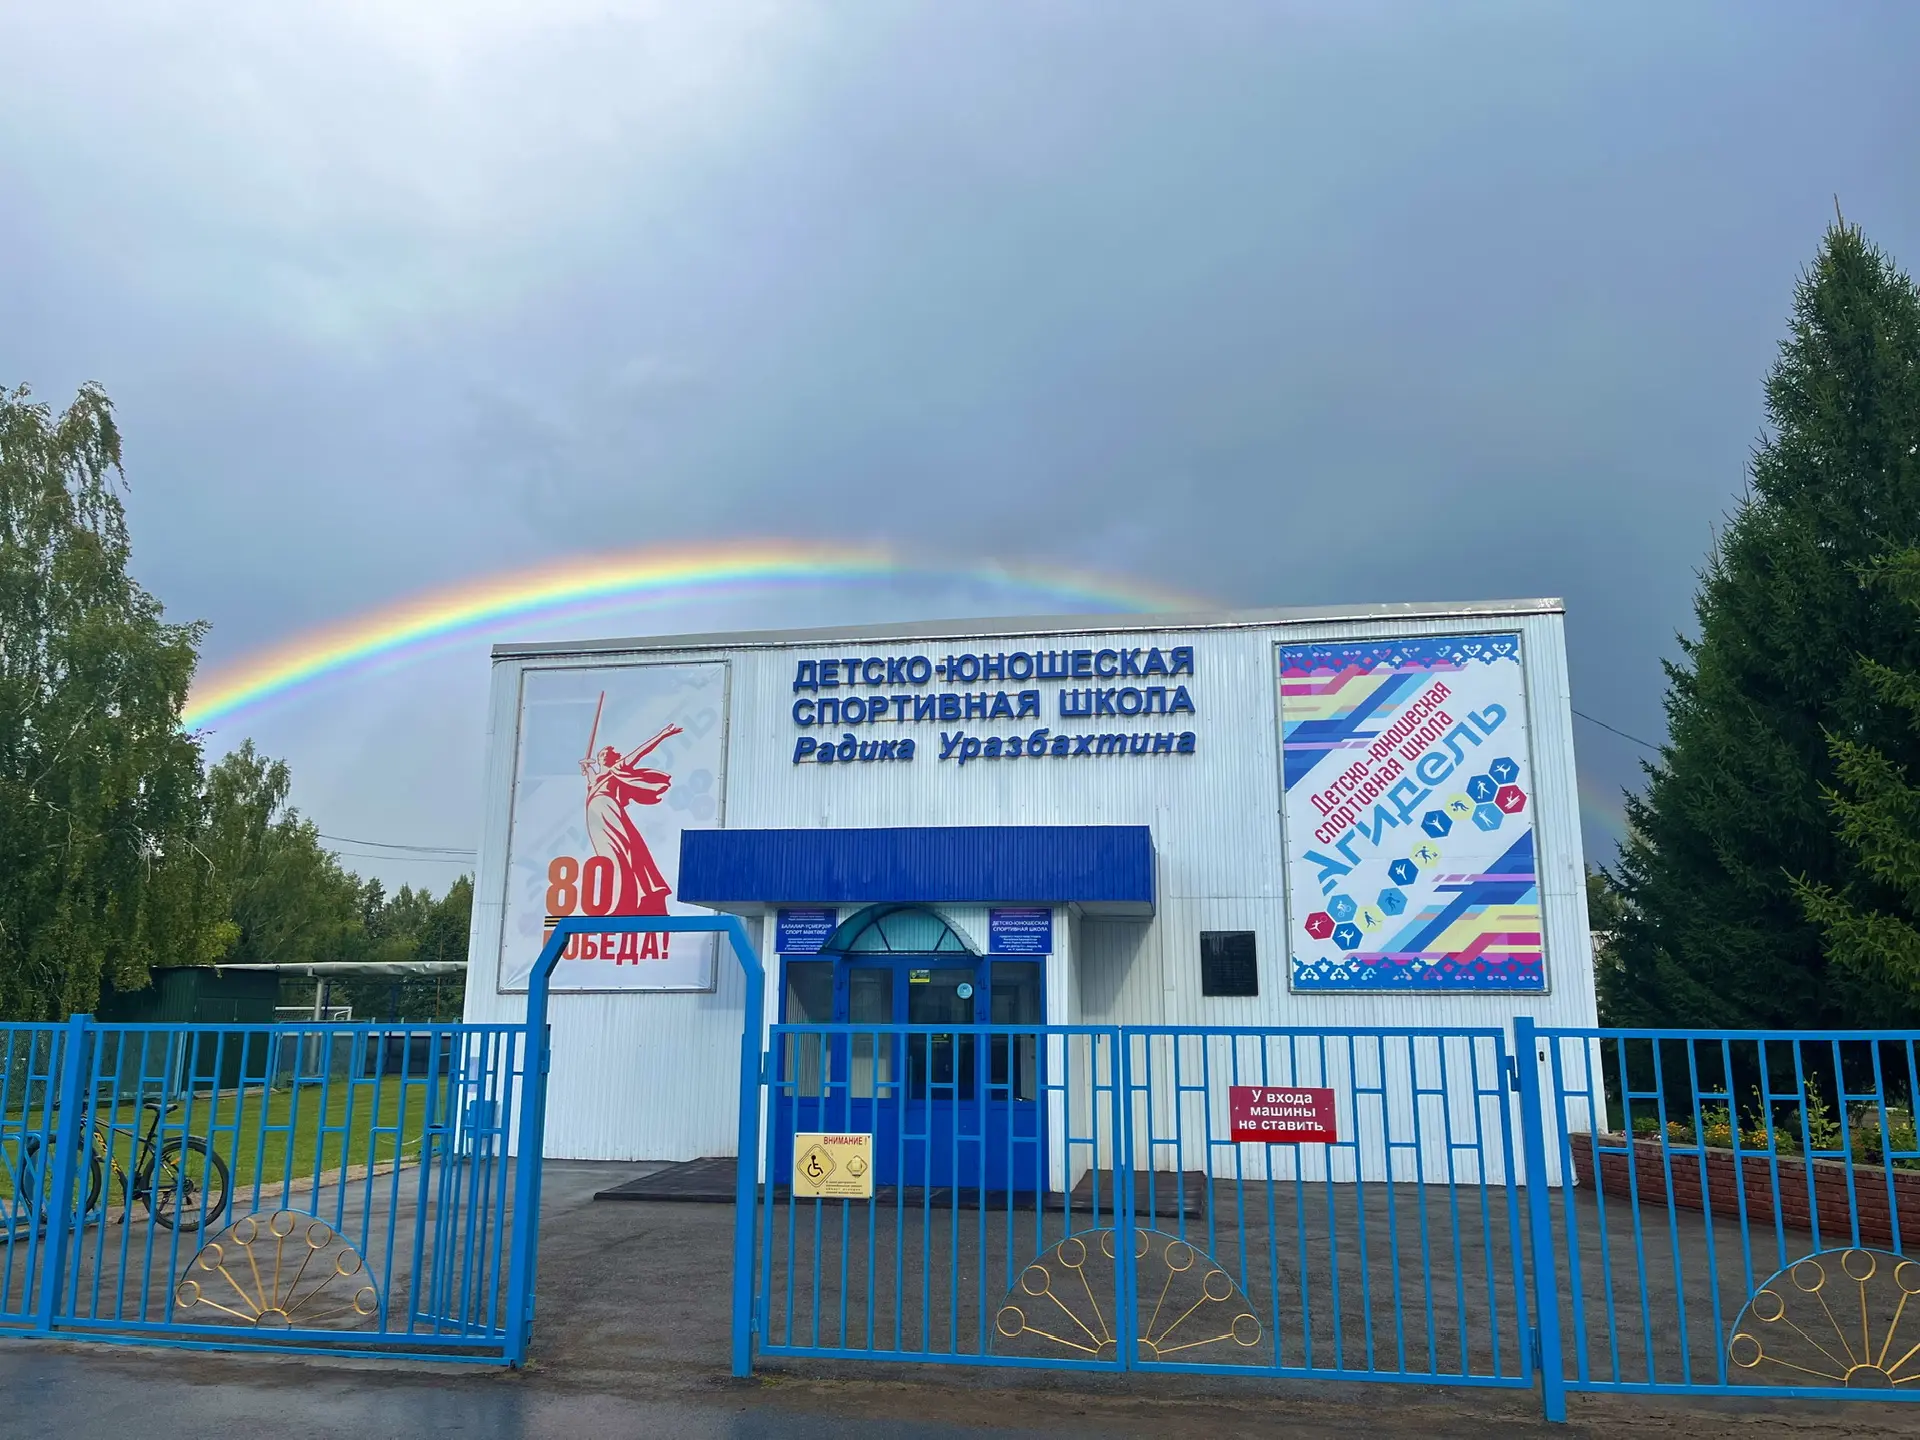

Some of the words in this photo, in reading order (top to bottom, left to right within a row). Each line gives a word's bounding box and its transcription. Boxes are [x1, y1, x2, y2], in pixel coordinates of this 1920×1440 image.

[793, 646, 1194, 693] ДЕТСКО-ЮНОШЕСКАЯ
[792, 689, 1040, 726] СПОРТИВНАЯ
[1059, 685, 1196, 718] ШКОЛА
[793, 733, 916, 764] Радика
[938, 728, 1197, 765] Уразбахтина
[1310, 681, 1452, 817] Детско-юношеская
[1314, 758, 1405, 845] спортивная
[1399, 710, 1454, 762] школа
[545, 855, 614, 917] 80
[543, 930, 670, 965] ОБЕДА!
[1250, 1106, 1316, 1117] машины
[1252, 1089, 1262, 1103] У
[1267, 1093, 1313, 1105] входа
[1239, 1120, 1257, 1130] не
[1261, 1120, 1324, 1131] ставить
